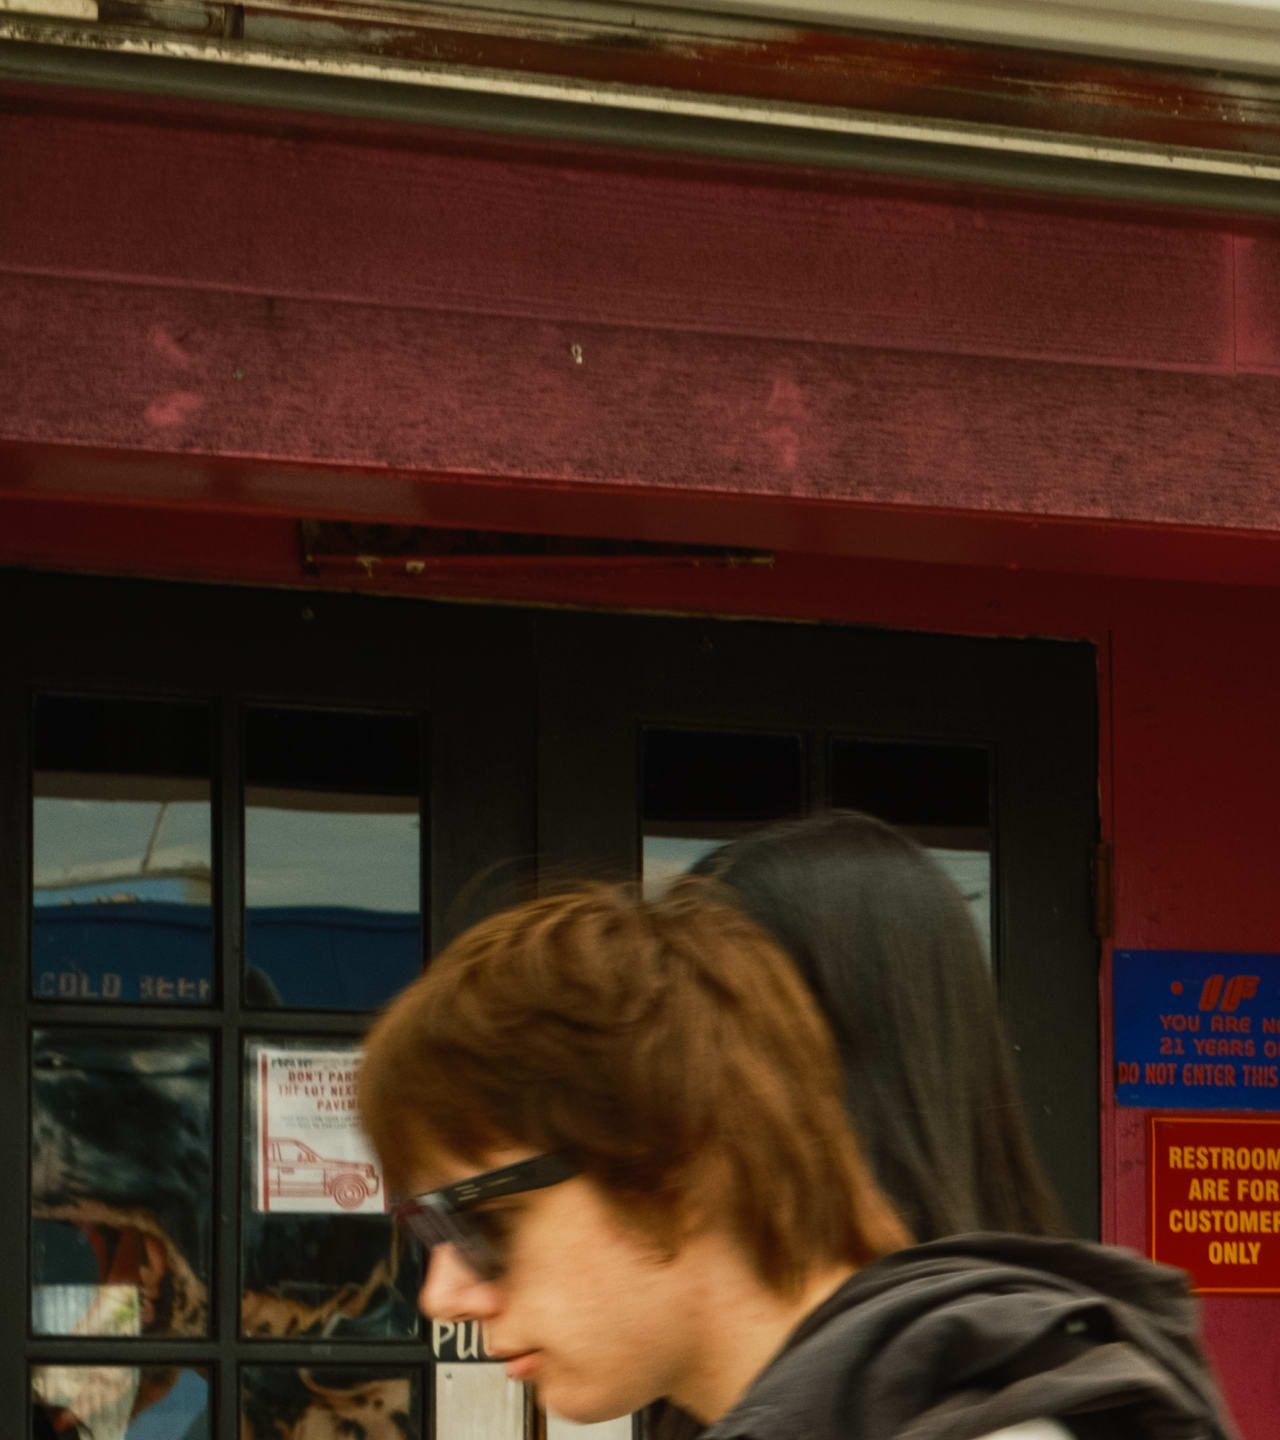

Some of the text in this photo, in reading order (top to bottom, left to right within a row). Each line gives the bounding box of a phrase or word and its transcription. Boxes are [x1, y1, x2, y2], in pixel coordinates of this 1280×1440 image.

[1198, 974, 1261, 1012] IF
[1159, 1014, 1201, 1032] YOU
[1210, 1015, 1251, 1034] ARE
[1159, 1036, 1184, 1055] 21
[1193, 1038, 1256, 1058] YEARS
[1118, 1062, 1140, 1085] DO
[1145, 1062, 1176, 1086] NOT
[1182, 1063, 1236, 1088] ENTER
[1243, 1065, 1279, 1089] THIS
[1188, 1178, 1280, 1202] ARE FOR
[1208, 1241, 1262, 1265] ONLY
